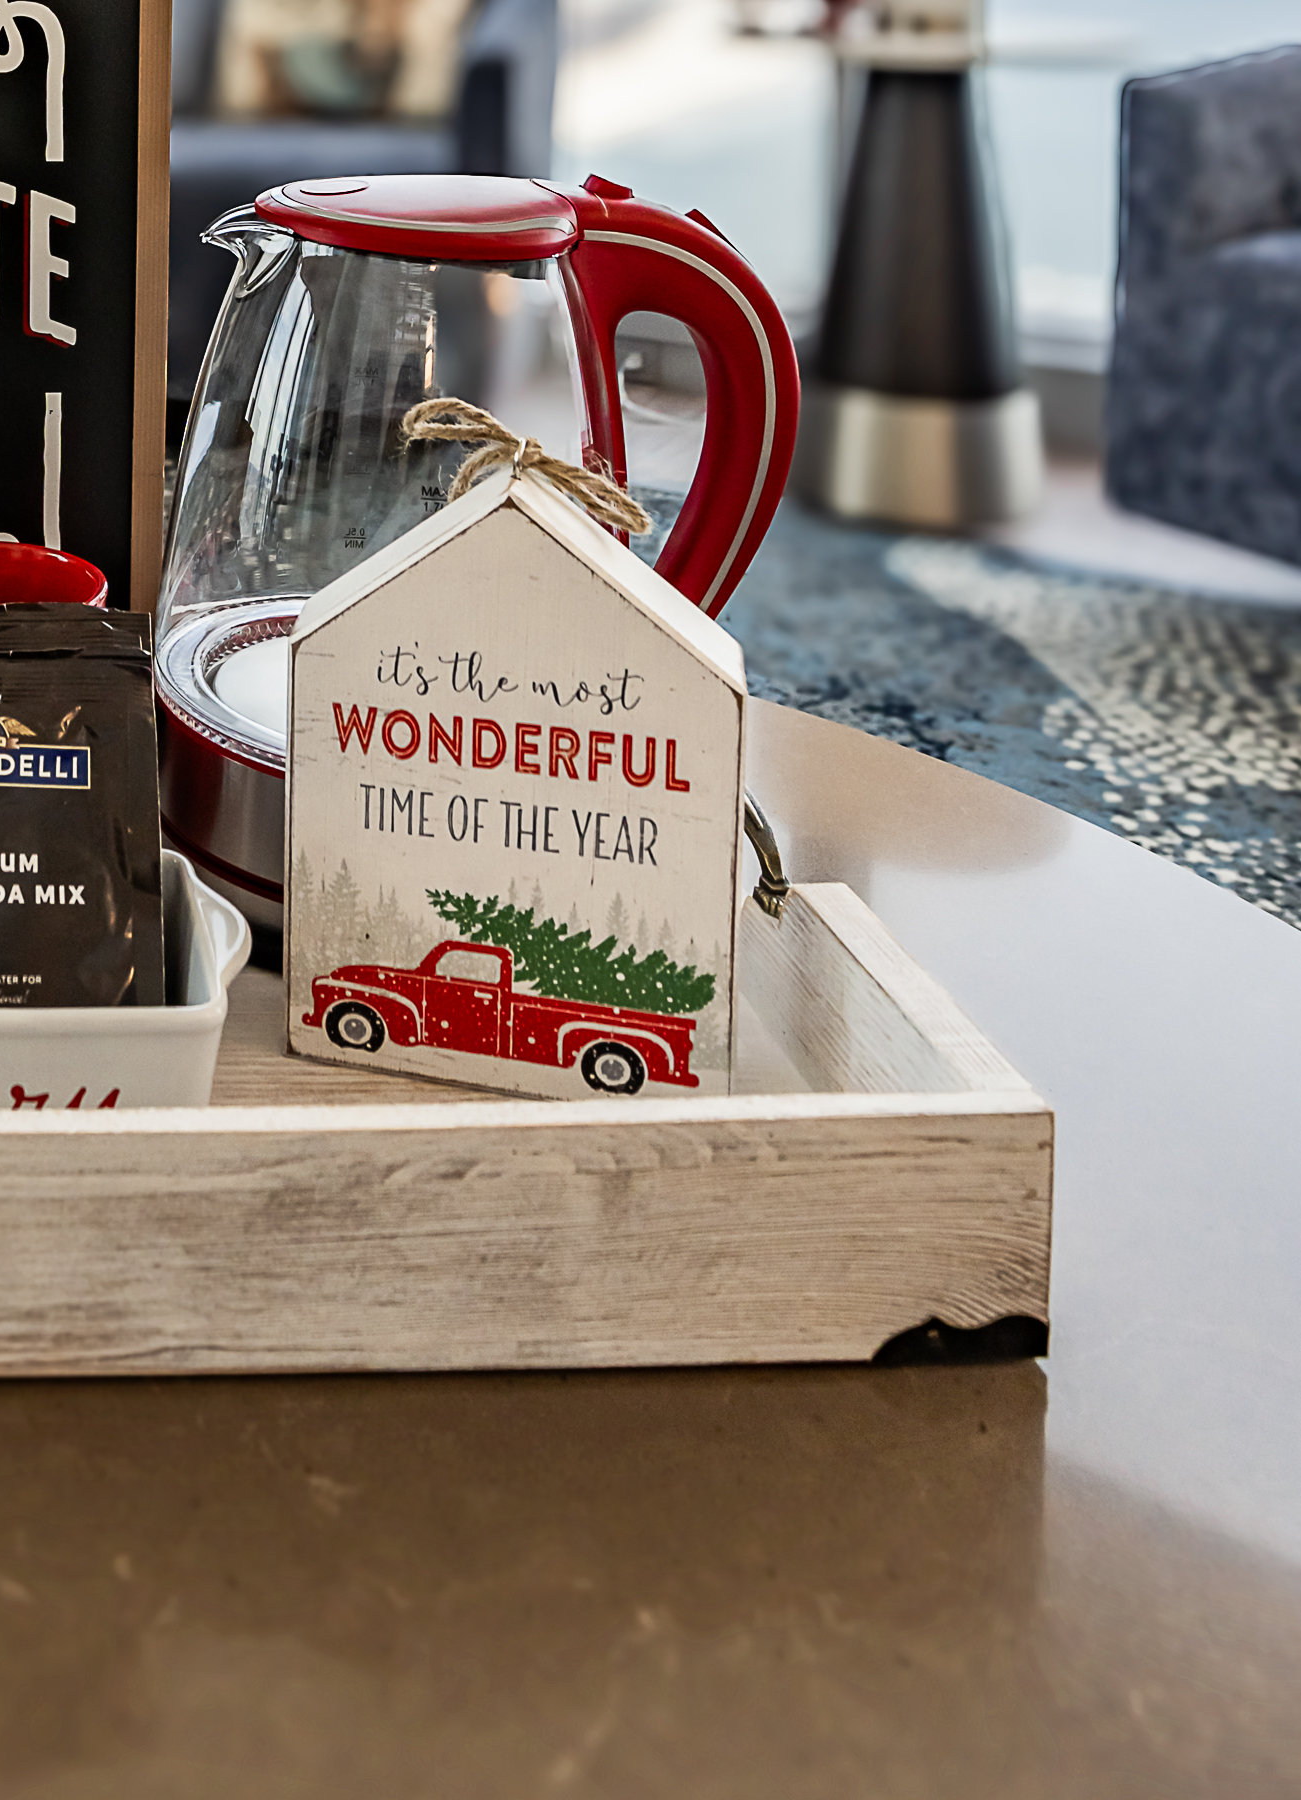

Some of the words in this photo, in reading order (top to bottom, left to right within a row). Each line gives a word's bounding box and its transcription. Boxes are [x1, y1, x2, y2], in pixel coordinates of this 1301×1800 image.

[376, 641, 438, 696] it's
[438, 650, 519, 702] the
[531, 668, 645, 716] most
[332, 702, 691, 793] WONDERFUL
[359, 783, 435, 838] TIME
[447, 794, 489, 844] OF
[500, 800, 560, 854] THE
[571, 809, 659, 867] YEAR
[35, 884, 87, 905] MIX
[23, 975, 42, 985] FOR
